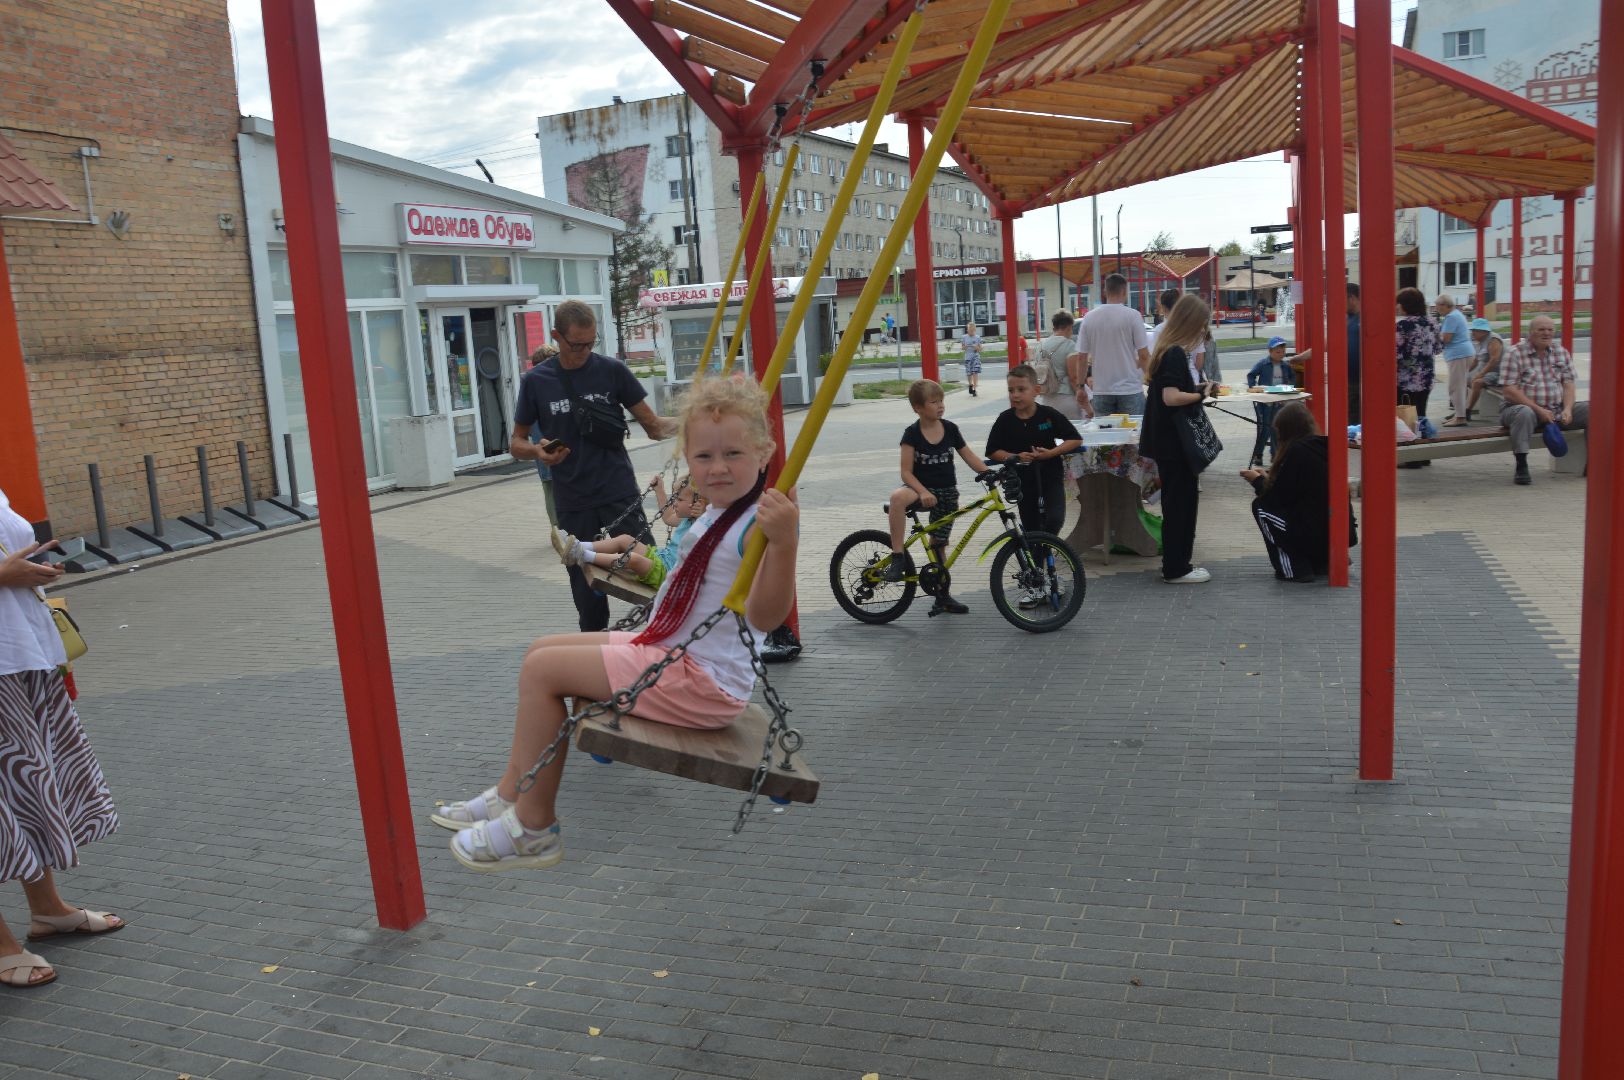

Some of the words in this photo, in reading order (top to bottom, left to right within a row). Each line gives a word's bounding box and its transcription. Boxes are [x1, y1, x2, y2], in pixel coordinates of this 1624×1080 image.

[408, 208, 480, 238] Одежда
[485, 215, 532, 246] Обувь
[653, 289, 707, 302] СВЕЖАЯ
